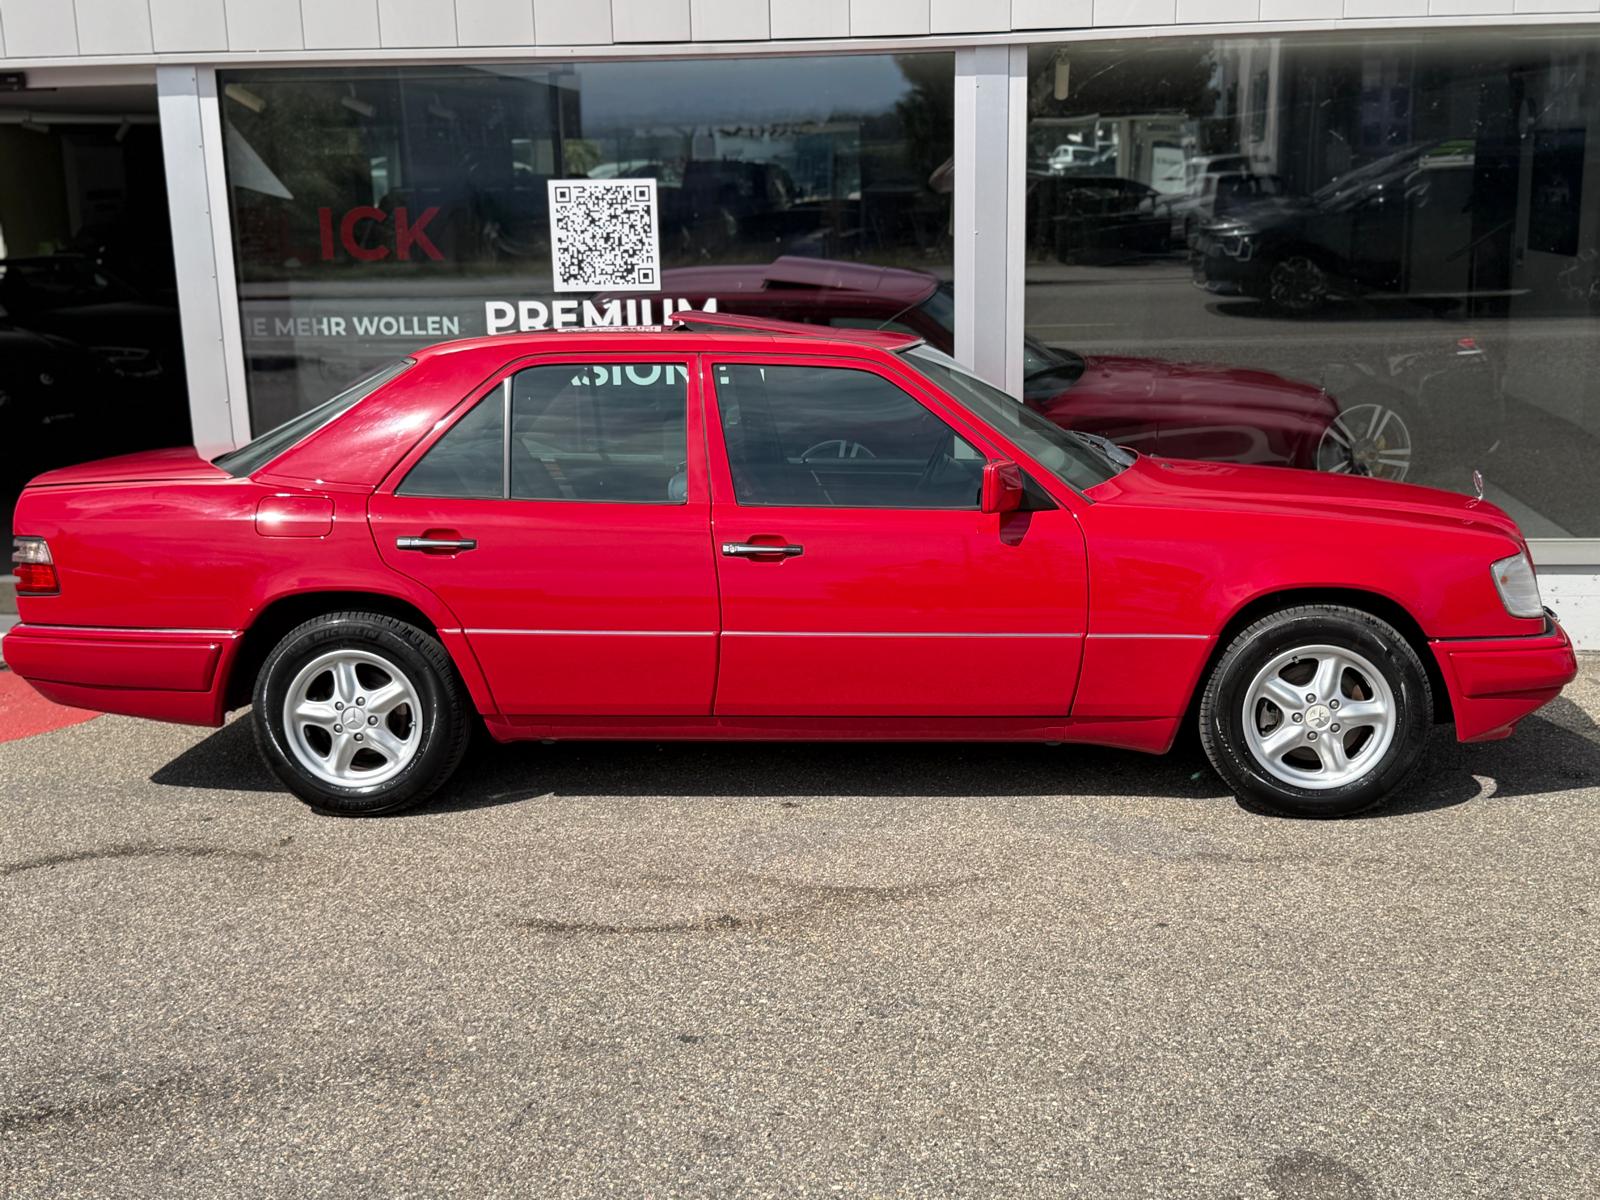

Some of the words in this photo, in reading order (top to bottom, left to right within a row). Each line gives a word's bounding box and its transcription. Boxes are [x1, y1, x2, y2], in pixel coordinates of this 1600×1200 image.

[245, 317, 268, 336] IE
[275, 316, 346, 336] MEHR
[352, 316, 459, 335] WOLLEN
